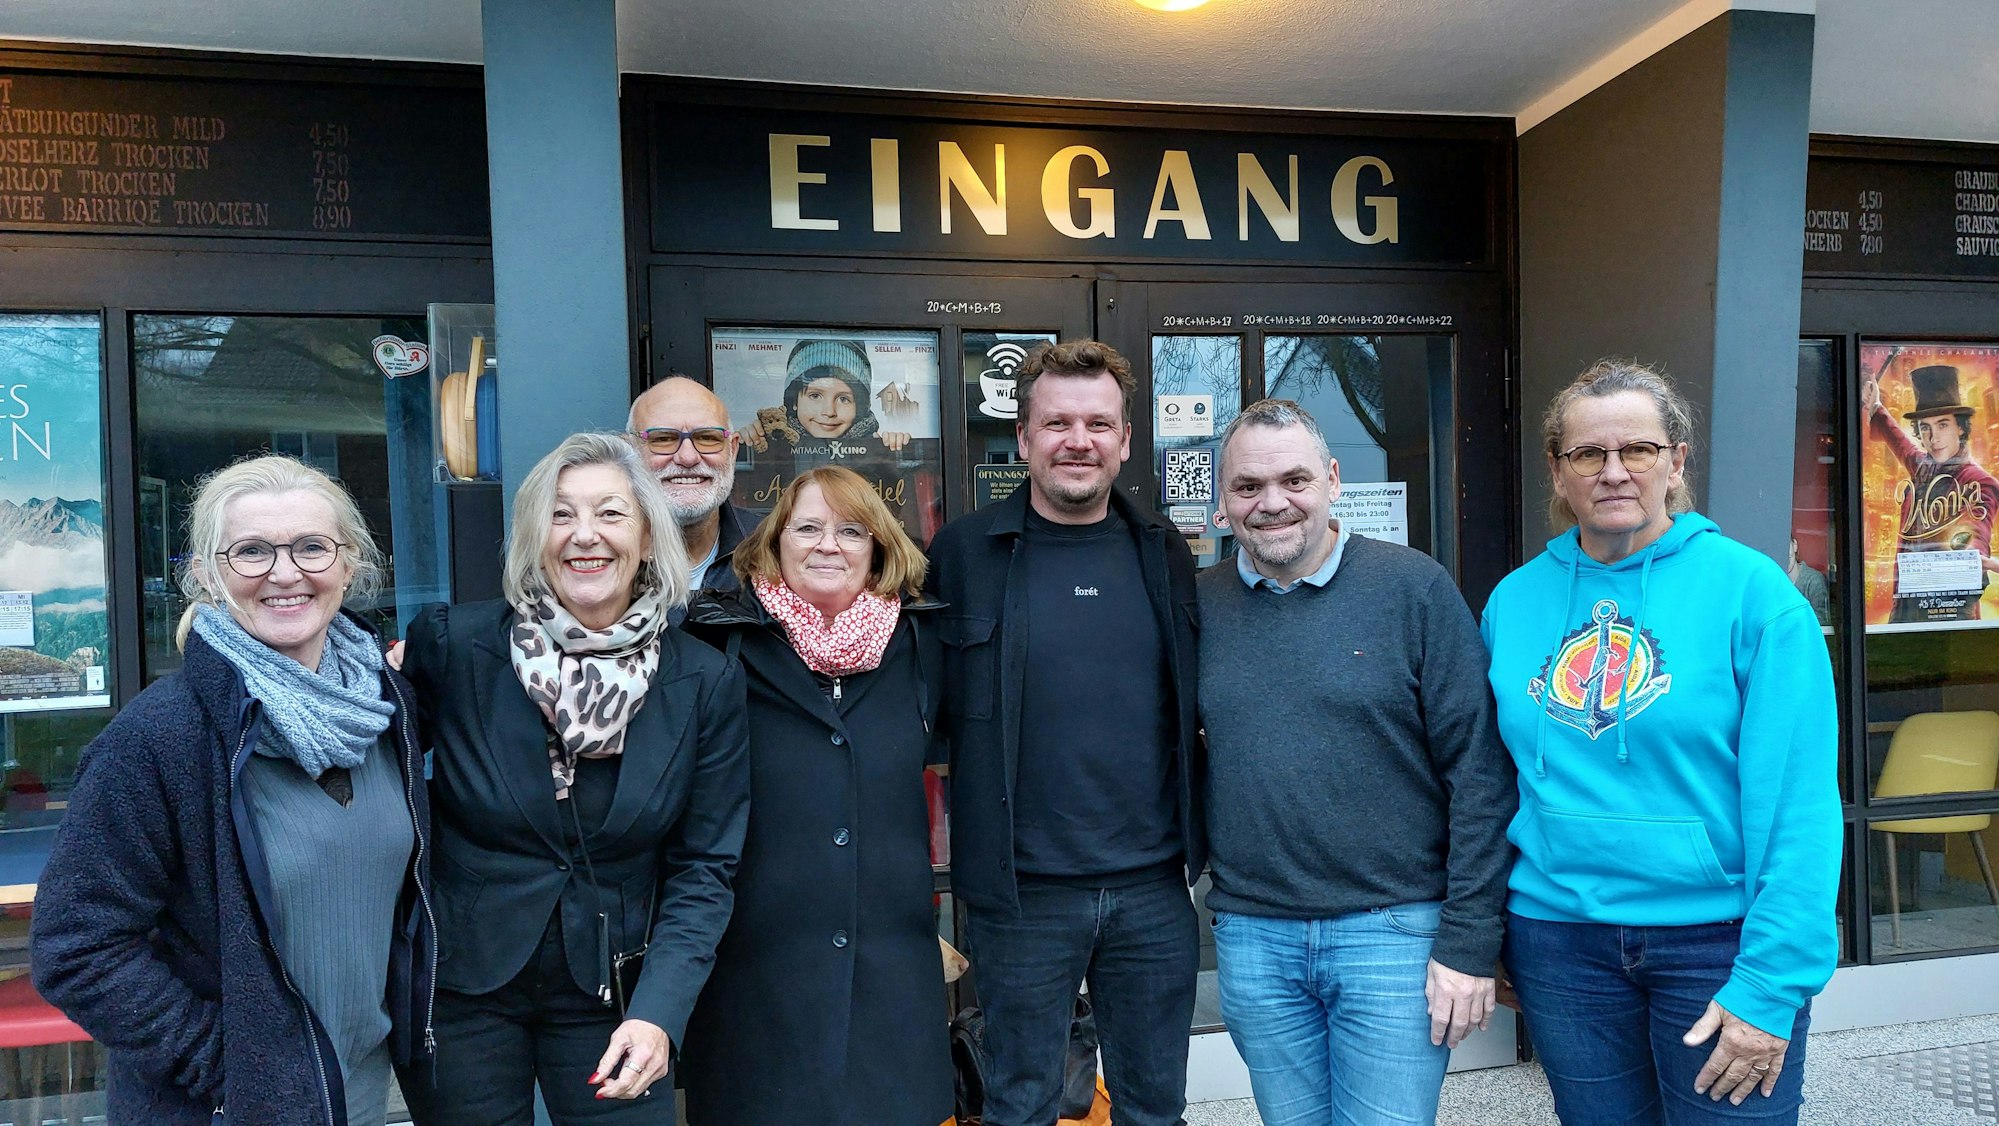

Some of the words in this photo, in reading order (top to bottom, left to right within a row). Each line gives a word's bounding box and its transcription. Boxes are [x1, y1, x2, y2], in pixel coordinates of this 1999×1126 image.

[172, 115, 225, 141] MILD
[309, 122, 348, 148] 4,50
[111, 142, 209, 170] TROCKEN
[312, 151, 349, 177] 7,50
[0, 167, 62, 193] RLOT
[77, 170, 176, 196] TROCKEN
[312, 178, 349, 204] 7,50
[768, 133, 1400, 246] EINGANG
[0, 196, 45, 220] VEE
[63, 198, 161, 226] BARRIQE
[173, 201, 269, 226] TROCKEN
[1859, 190, 1883, 211] 4,50
[312, 206, 351, 231] 8,90
[1805, 210, 1849, 230] OCKEN
[1859, 212, 1883, 233] 4,50
[1860, 234, 1883, 256] 7,80
[791, 447, 831, 455] MITMACH
[1894, 473, 1988, 534] Wonka
